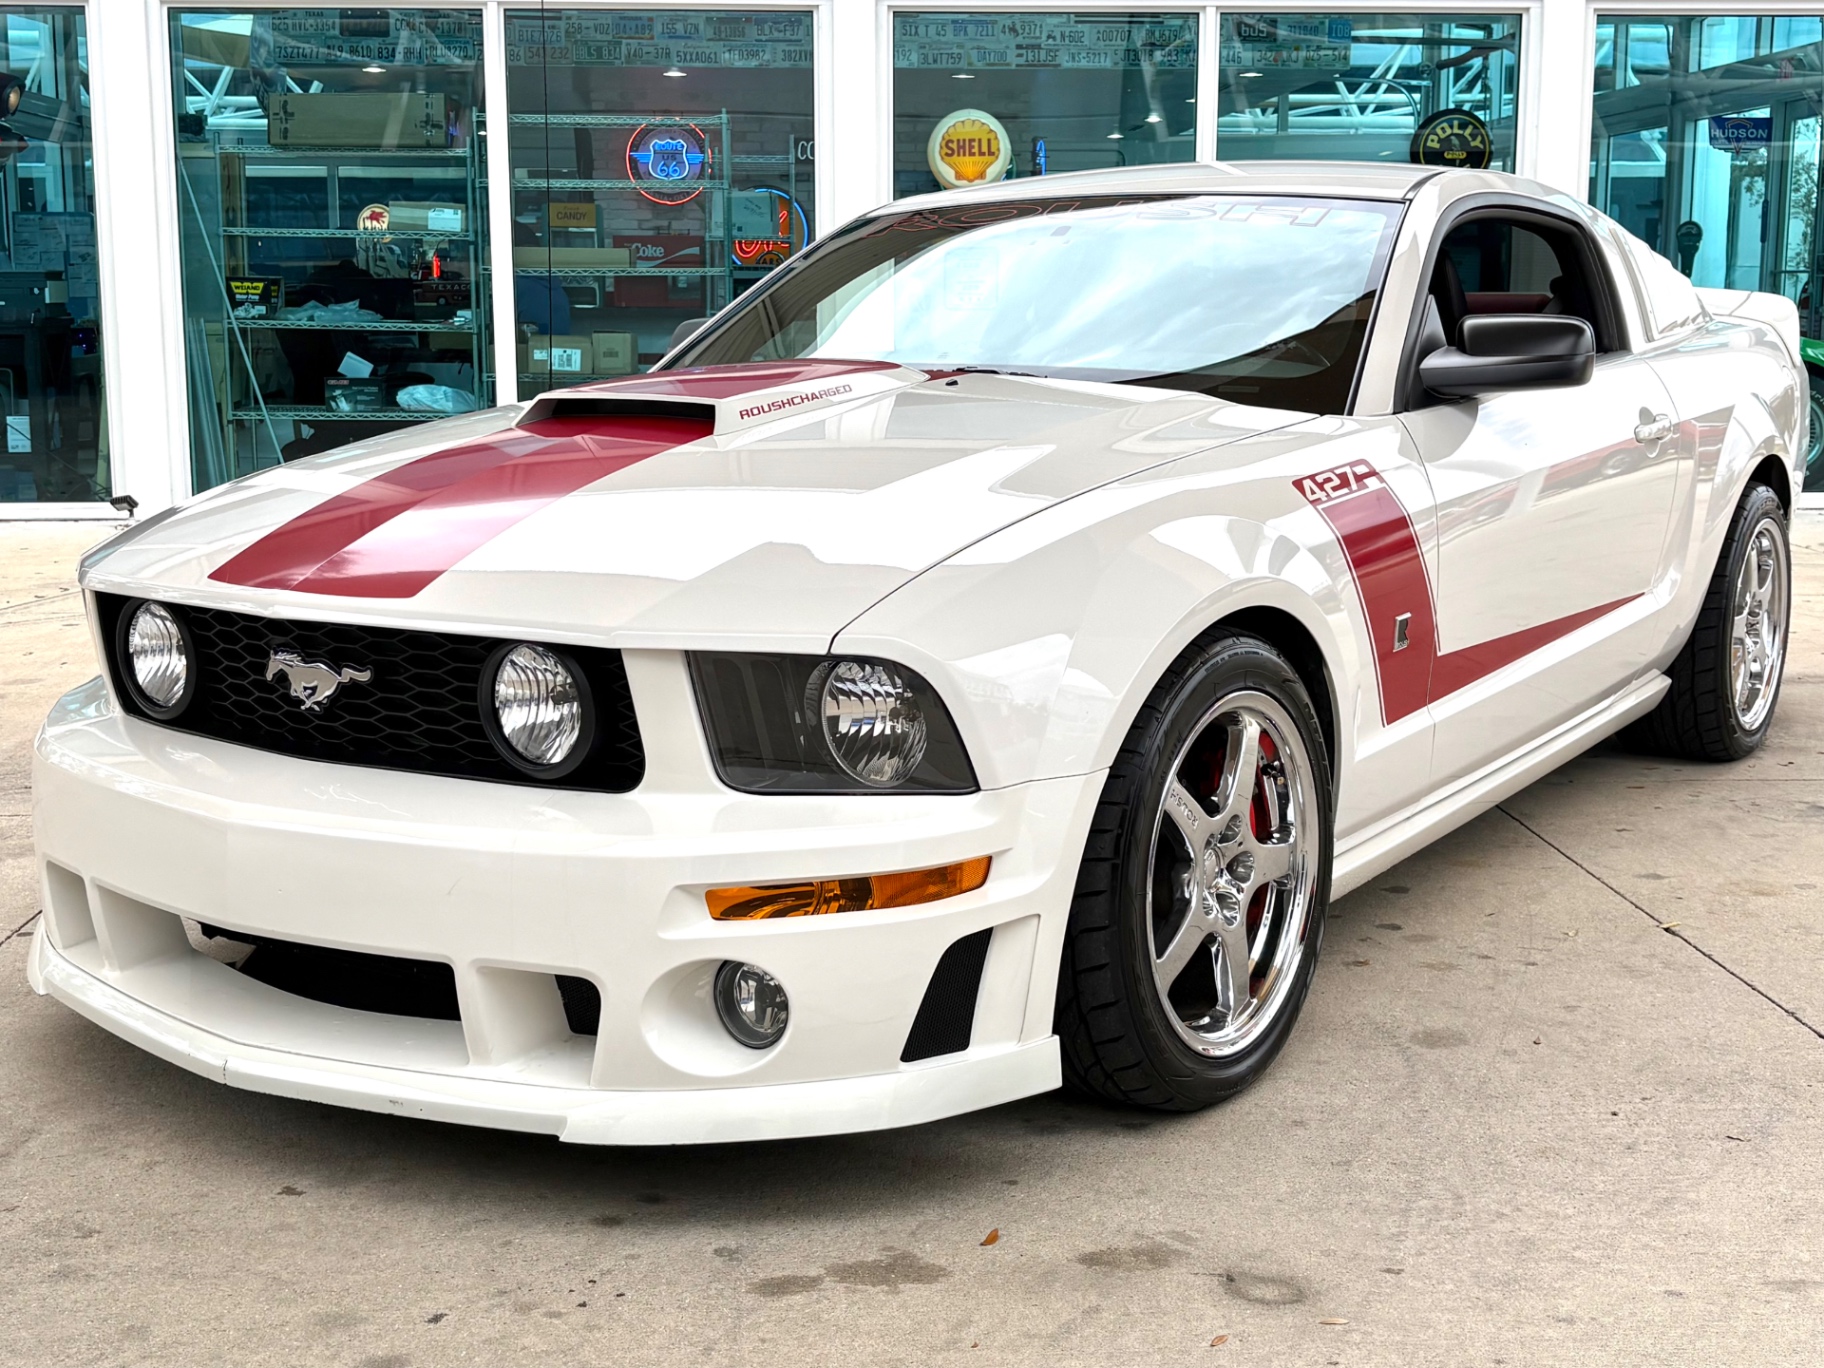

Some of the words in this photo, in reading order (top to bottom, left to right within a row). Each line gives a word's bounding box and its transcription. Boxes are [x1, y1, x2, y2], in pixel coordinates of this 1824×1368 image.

[1426, 120, 1484, 150] POLLY
[1711, 128, 1768, 139] HUDSON
[654, 141, 684, 151] ROUTE
[944, 137, 997, 158] SHELL
[657, 160, 681, 177] 66
[556, 211, 588, 221] CANDY
[632, 242, 665, 258] Coke
[739, 384, 853, 420] ROUSHCHARGED
